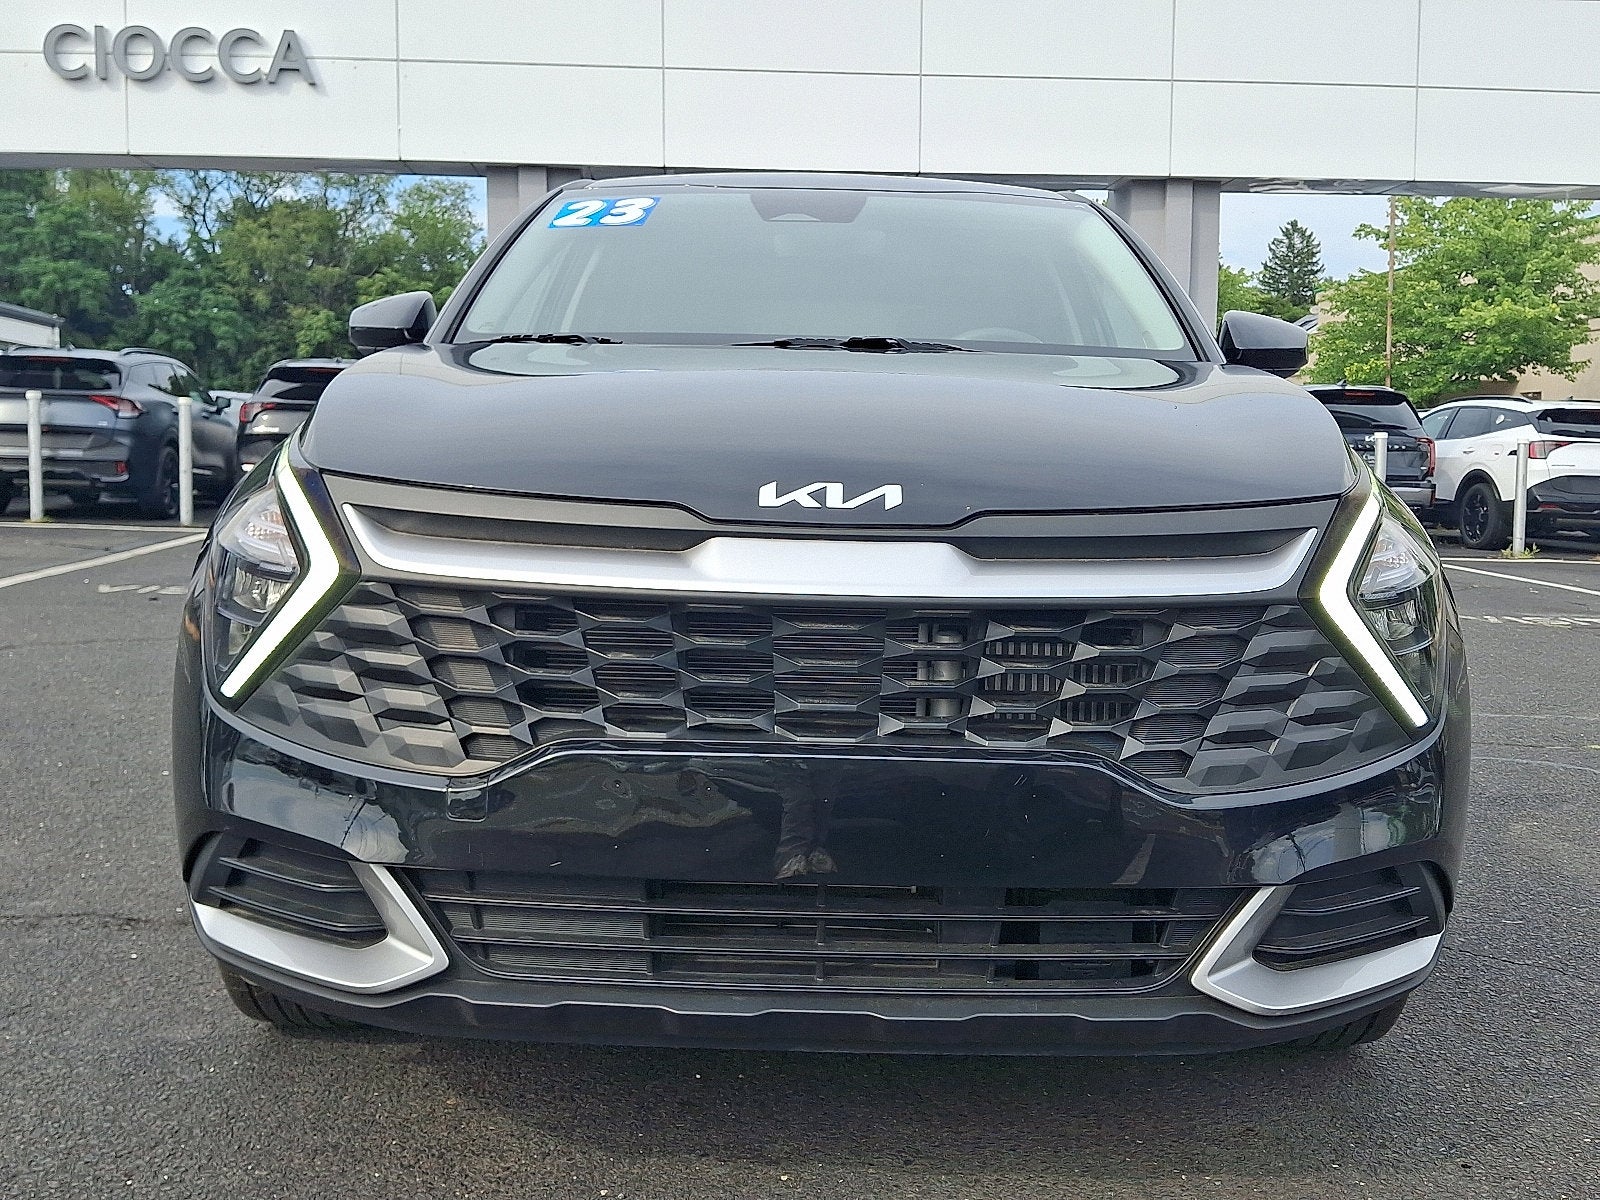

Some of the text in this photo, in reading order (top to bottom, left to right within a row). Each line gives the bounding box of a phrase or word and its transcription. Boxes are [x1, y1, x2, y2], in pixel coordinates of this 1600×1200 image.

[44, 24, 316, 86] CIOCCA
[552, 198, 656, 226] 23
[758, 481, 904, 511] KIA
